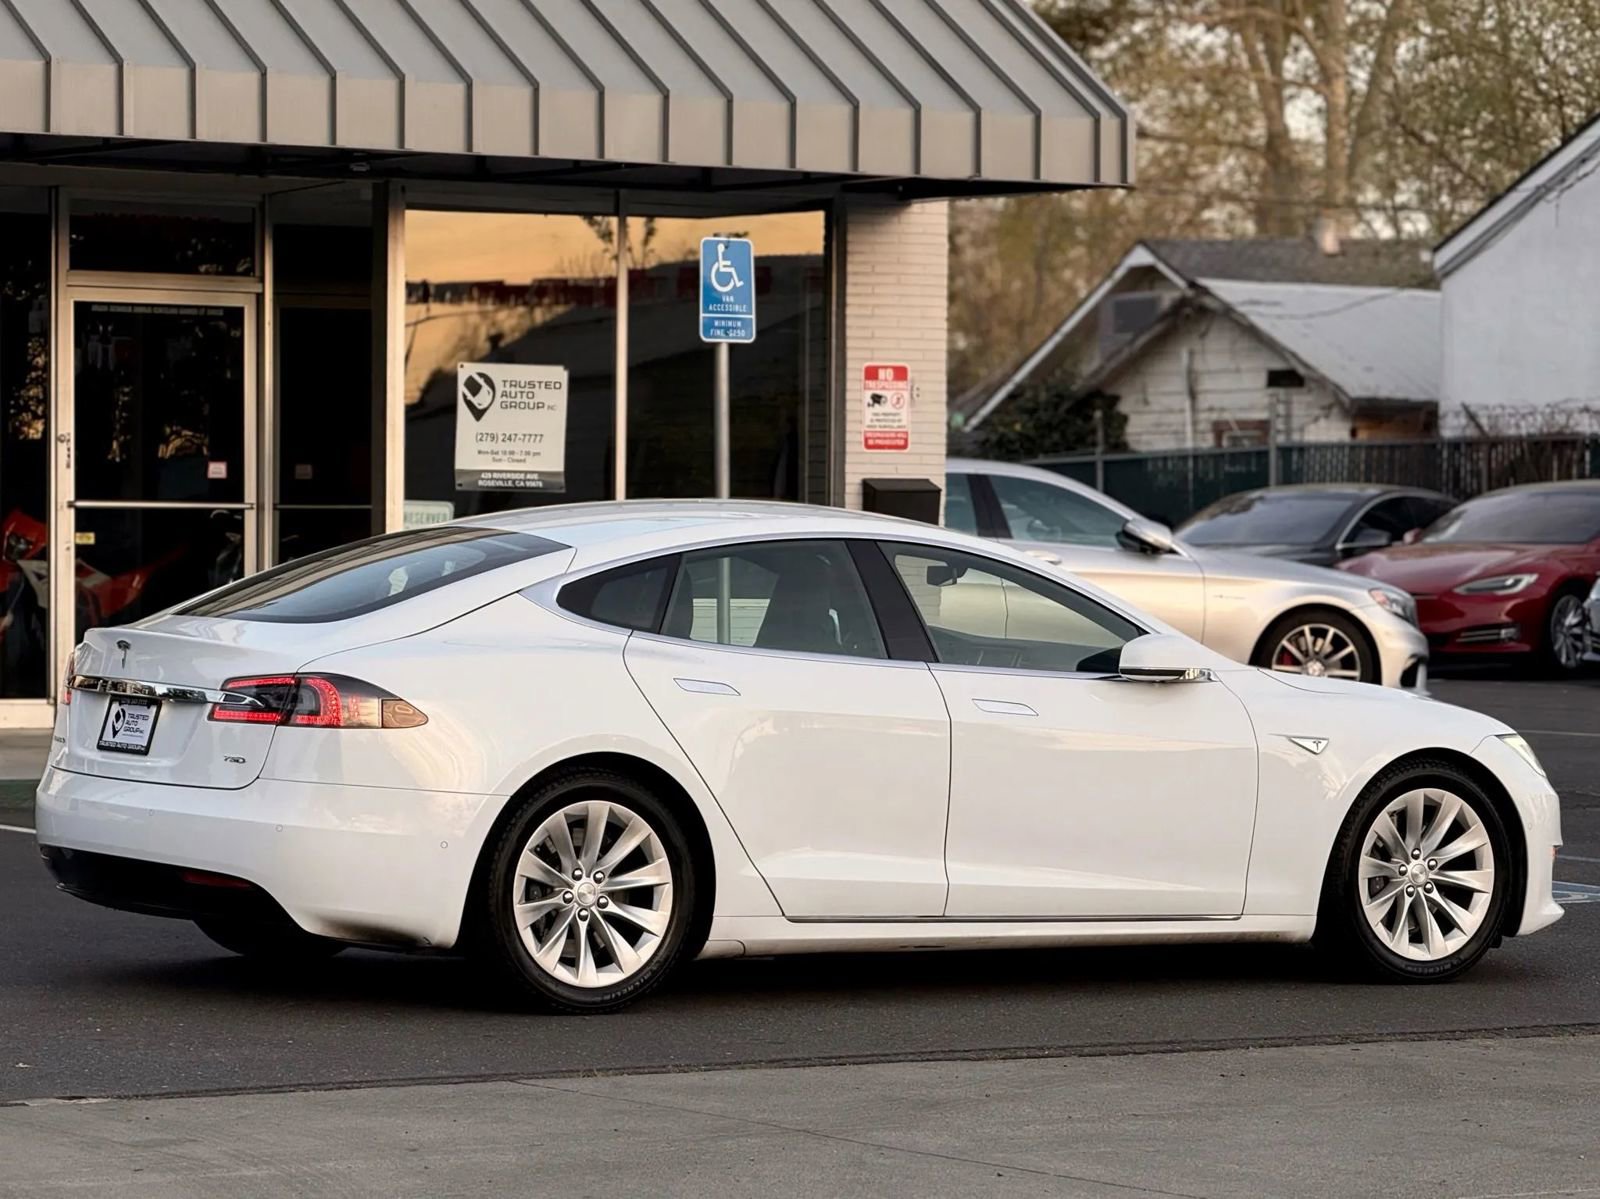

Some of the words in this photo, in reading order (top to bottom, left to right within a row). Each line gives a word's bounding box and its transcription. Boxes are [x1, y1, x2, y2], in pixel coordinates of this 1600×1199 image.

[721, 295, 735, 303] VAN
[708, 303, 747, 312] ACCESSIBLE
[713, 319, 742, 328] MINIMUM
[709, 328, 726, 337] FINE
[877, 367, 894, 381] NO
[501, 379, 563, 390] TRUSTED
[500, 390, 535, 400] AUTO
[500, 400, 546, 411] GROUP
[475, 432, 499, 444] (279)
[501, 433, 544, 444] 247-7777
[492, 472, 525, 480] RIVERSIDE
[478, 479, 515, 488] ROSEVILLE,
[515, 480, 525, 488] CA
[127, 712, 150, 721] TRUSTED
[125, 719, 139, 727] AUTO
[123, 725, 140, 734] GROUP
[223, 756, 246, 764] 75D
